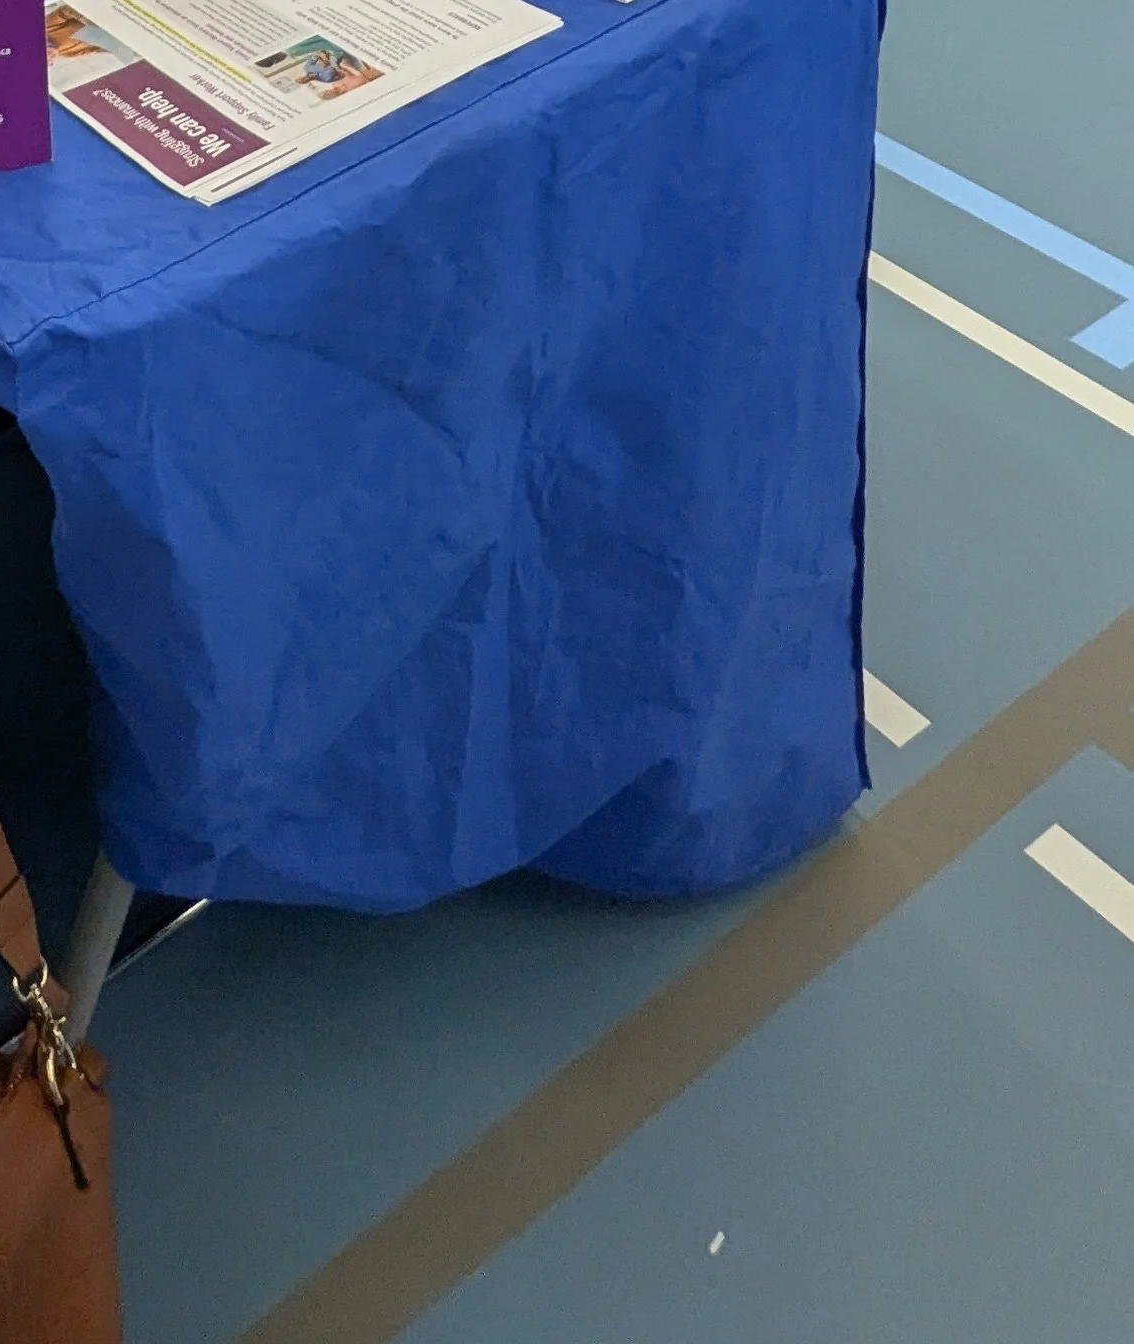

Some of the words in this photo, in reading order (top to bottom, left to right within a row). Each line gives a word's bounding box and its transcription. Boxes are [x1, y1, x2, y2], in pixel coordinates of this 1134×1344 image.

[188, 73, 219, 94] Worker
[93, 88, 135, 120] finances?
[138, 87, 178, 119] help.
[218, 91, 249, 116] Support
[134, 114, 159, 134] with
[170, 112, 206, 142] can
[248, 112, 275, 131] Family
[154, 125, 204, 167] Struggling
[199, 133, 231, 158] We
